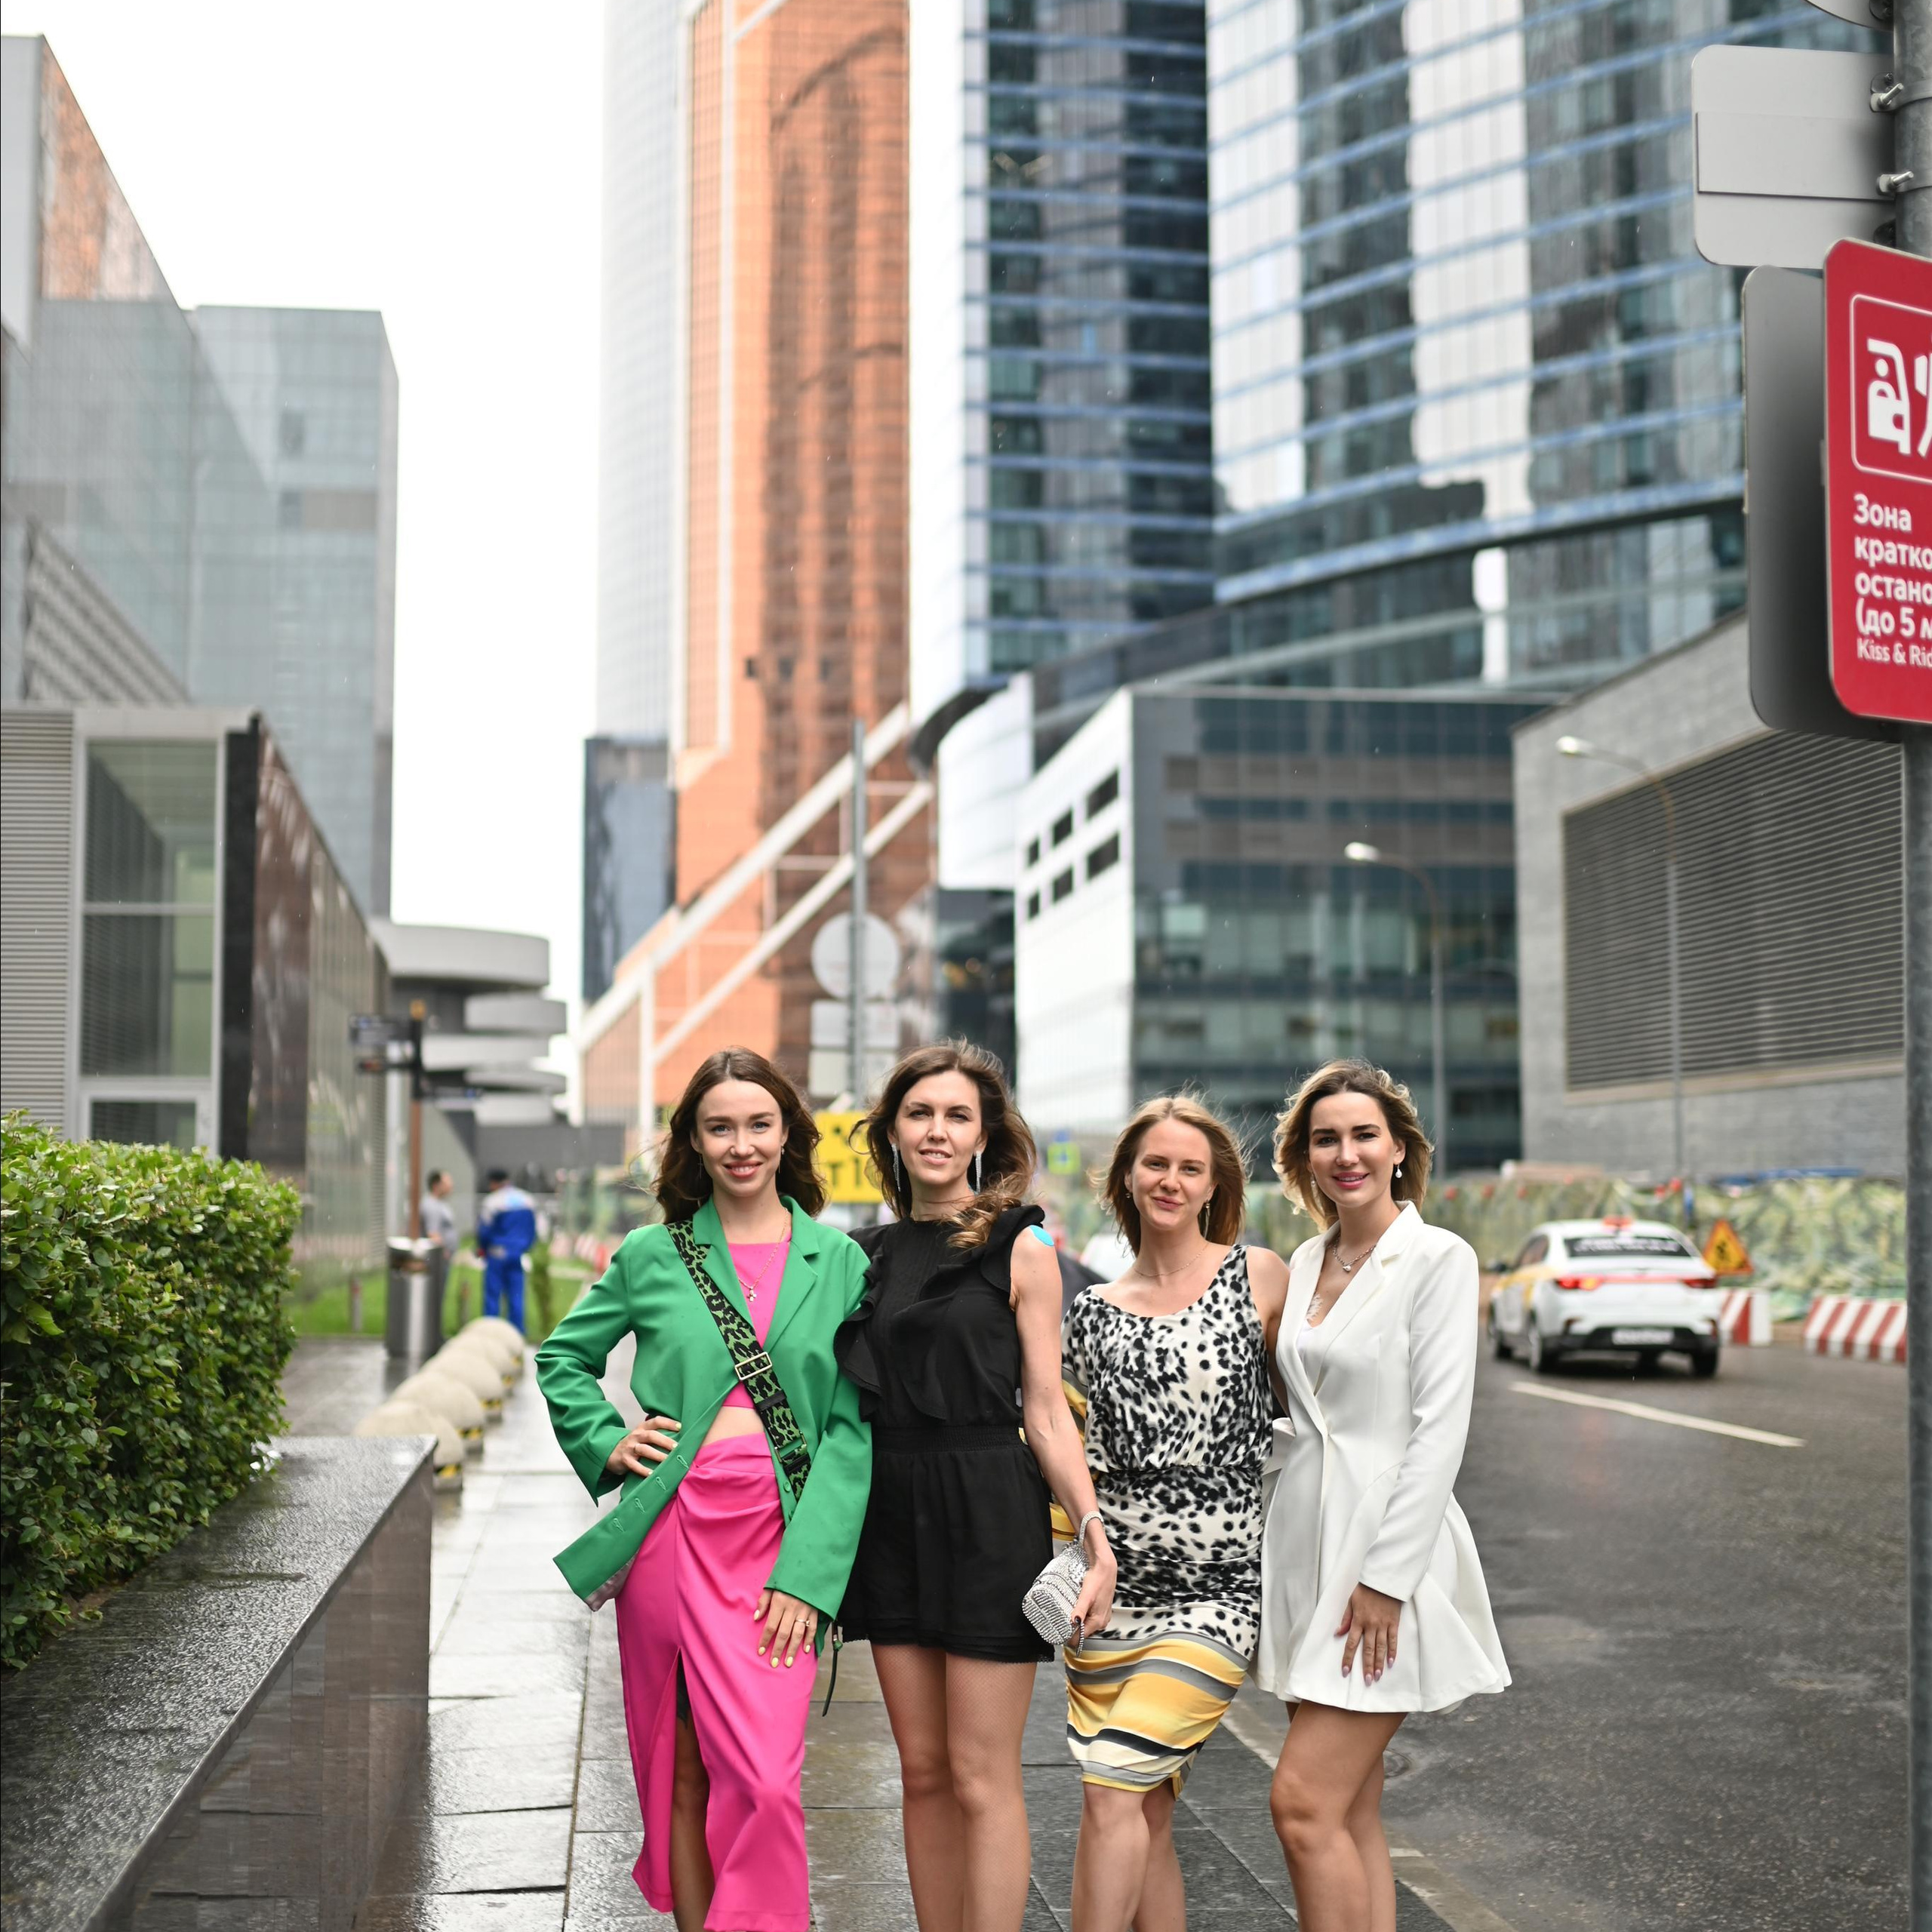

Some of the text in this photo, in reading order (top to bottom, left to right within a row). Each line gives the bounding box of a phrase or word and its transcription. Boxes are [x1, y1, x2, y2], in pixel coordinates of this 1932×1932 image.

[1854, 493, 1912, 532] Зона
[1854, 536, 1932, 571] кратко
[1855, 572, 1932, 605] остано
[1855, 597, 1895, 637] (до
[1900, 606, 1915, 637] 5
[1857, 638, 1890, 662] Kiss
[1892, 643, 1906, 664] &
